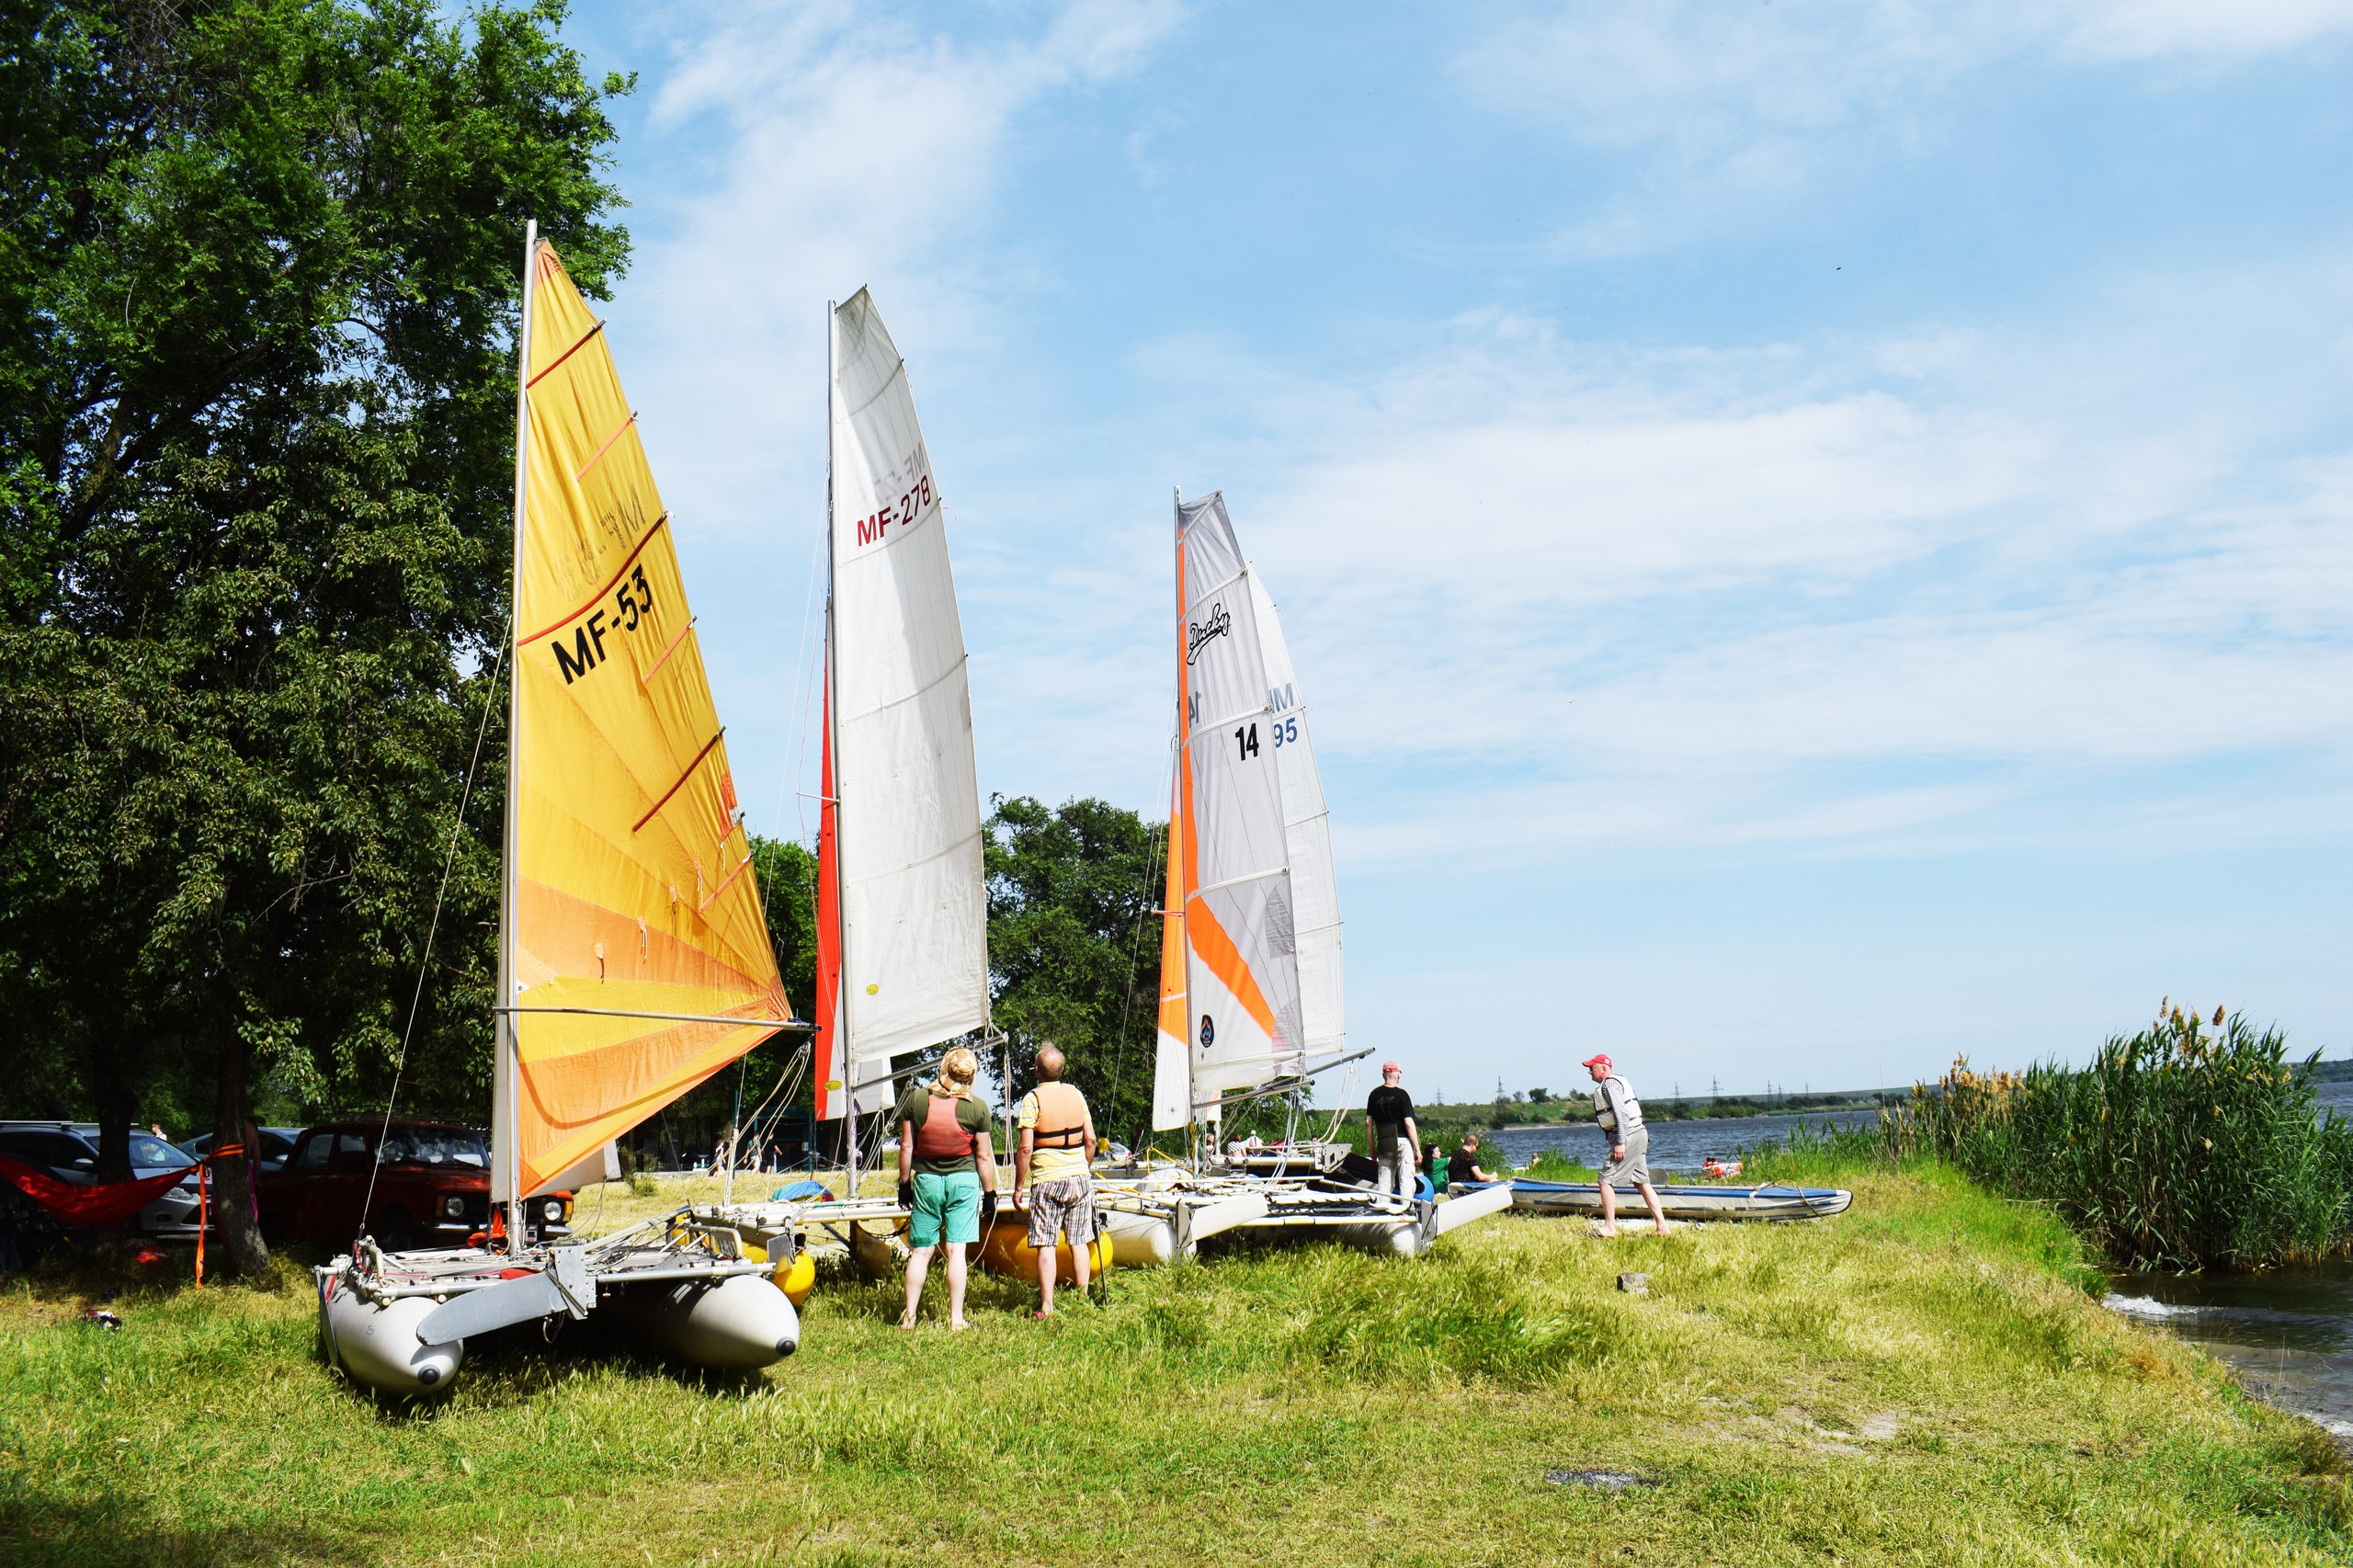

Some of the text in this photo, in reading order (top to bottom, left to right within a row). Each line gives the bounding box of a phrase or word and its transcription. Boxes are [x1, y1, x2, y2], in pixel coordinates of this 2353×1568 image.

[858, 474, 931, 547] MF-278
[551, 563, 652, 686] MF-53
[1235, 722, 1259, 761] 14
